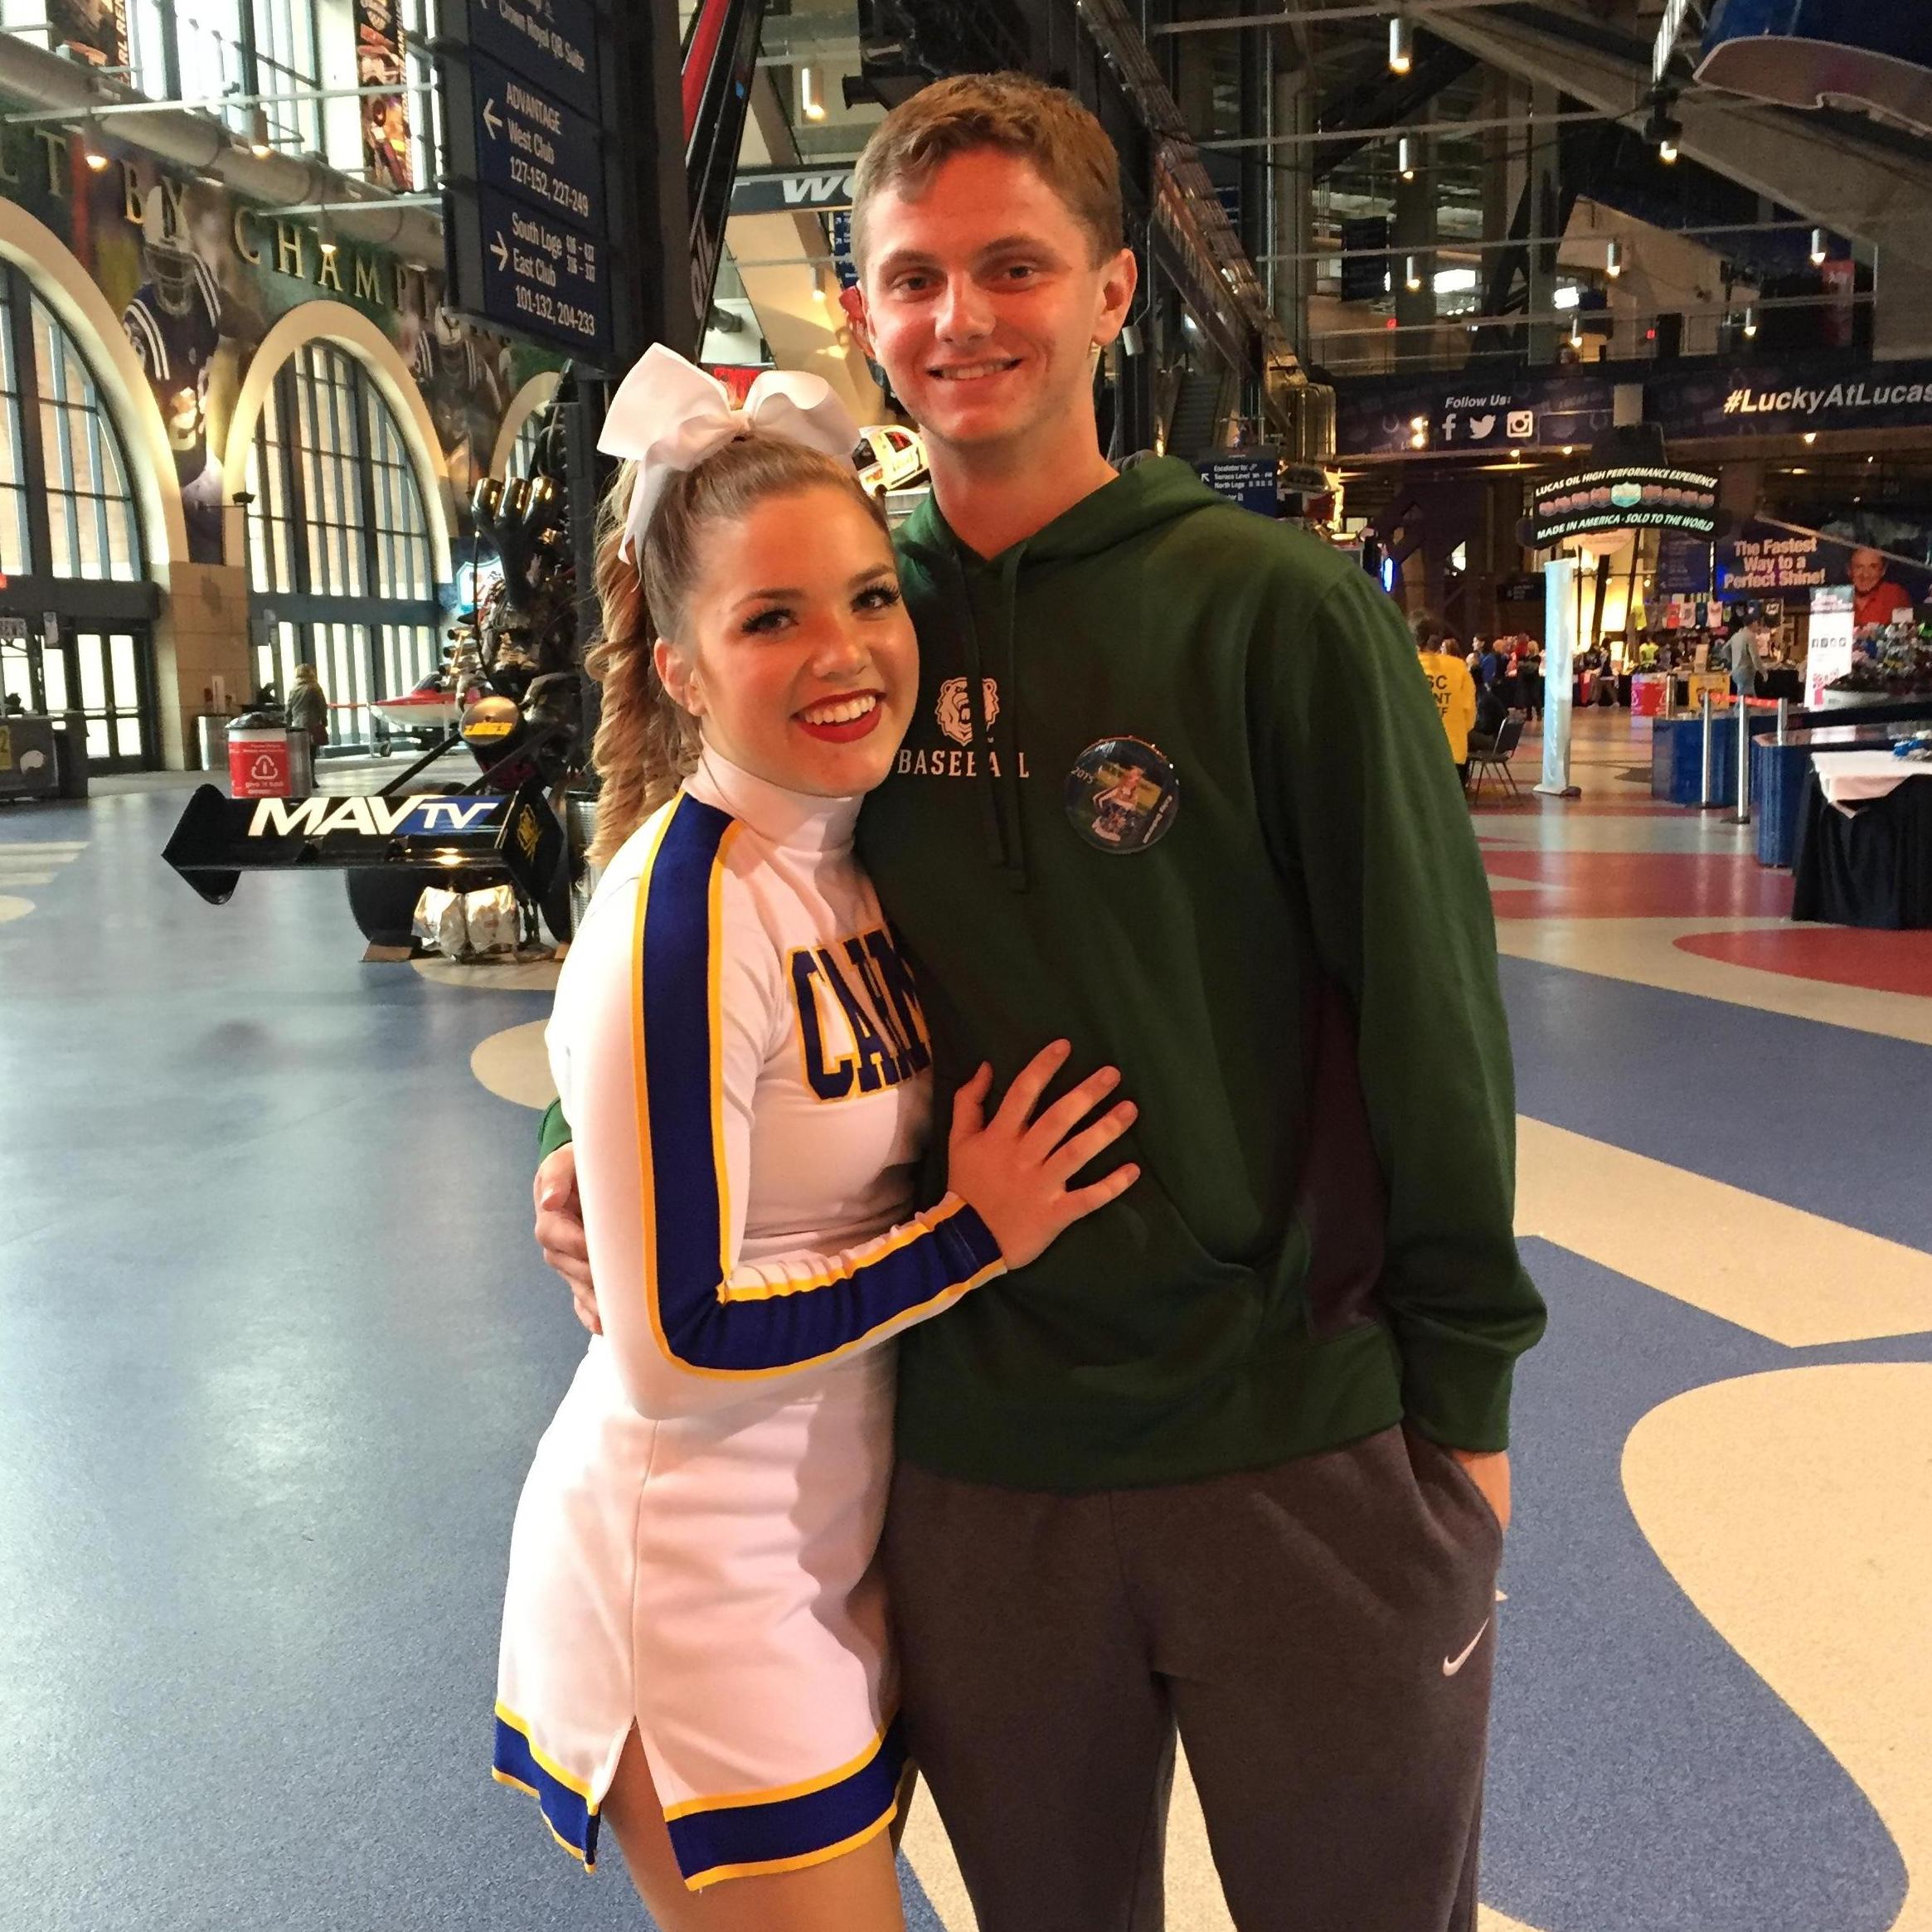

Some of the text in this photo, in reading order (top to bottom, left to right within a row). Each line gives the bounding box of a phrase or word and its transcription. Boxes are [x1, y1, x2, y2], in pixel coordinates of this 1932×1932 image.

[506, 81, 562, 137] ADVANTAGE
[507, 117, 556, 165] West Club
[510, 155, 590, 218] 127-152, 227-249
[512, 211, 539, 245] South
[541, 225, 562, 260] Loge
[234, 206, 434, 324] CHAMPI
[513, 247, 556, 287] East Club
[516, 284, 595, 336] 101-132, 204-233
[1444, 394, 1512, 409] Follow Us:
[1723, 382, 1932, 415] #LuckyAtLucas
[1535, 467, 1719, 498] LUCAS OIL HIGH PERFORMANCE EXPERIENCE
[1536, 522, 1566, 540] MADE
[1565, 520, 1577, 532] IN
[1576, 513, 1620, 530] AMERICA
[1625, 512, 1649, 524] SOLD
[1651, 513, 1663, 524] TO
[1664, 513, 1682, 525] THE
[1682, 515, 1715, 532] WORLD
[1734, 536, 1818, 557] The Fastest
[1743, 554, 1807, 574] Way to a
[1724, 567, 1826, 590] Perfect Shine!
[247, 795, 499, 837] MAVTV
